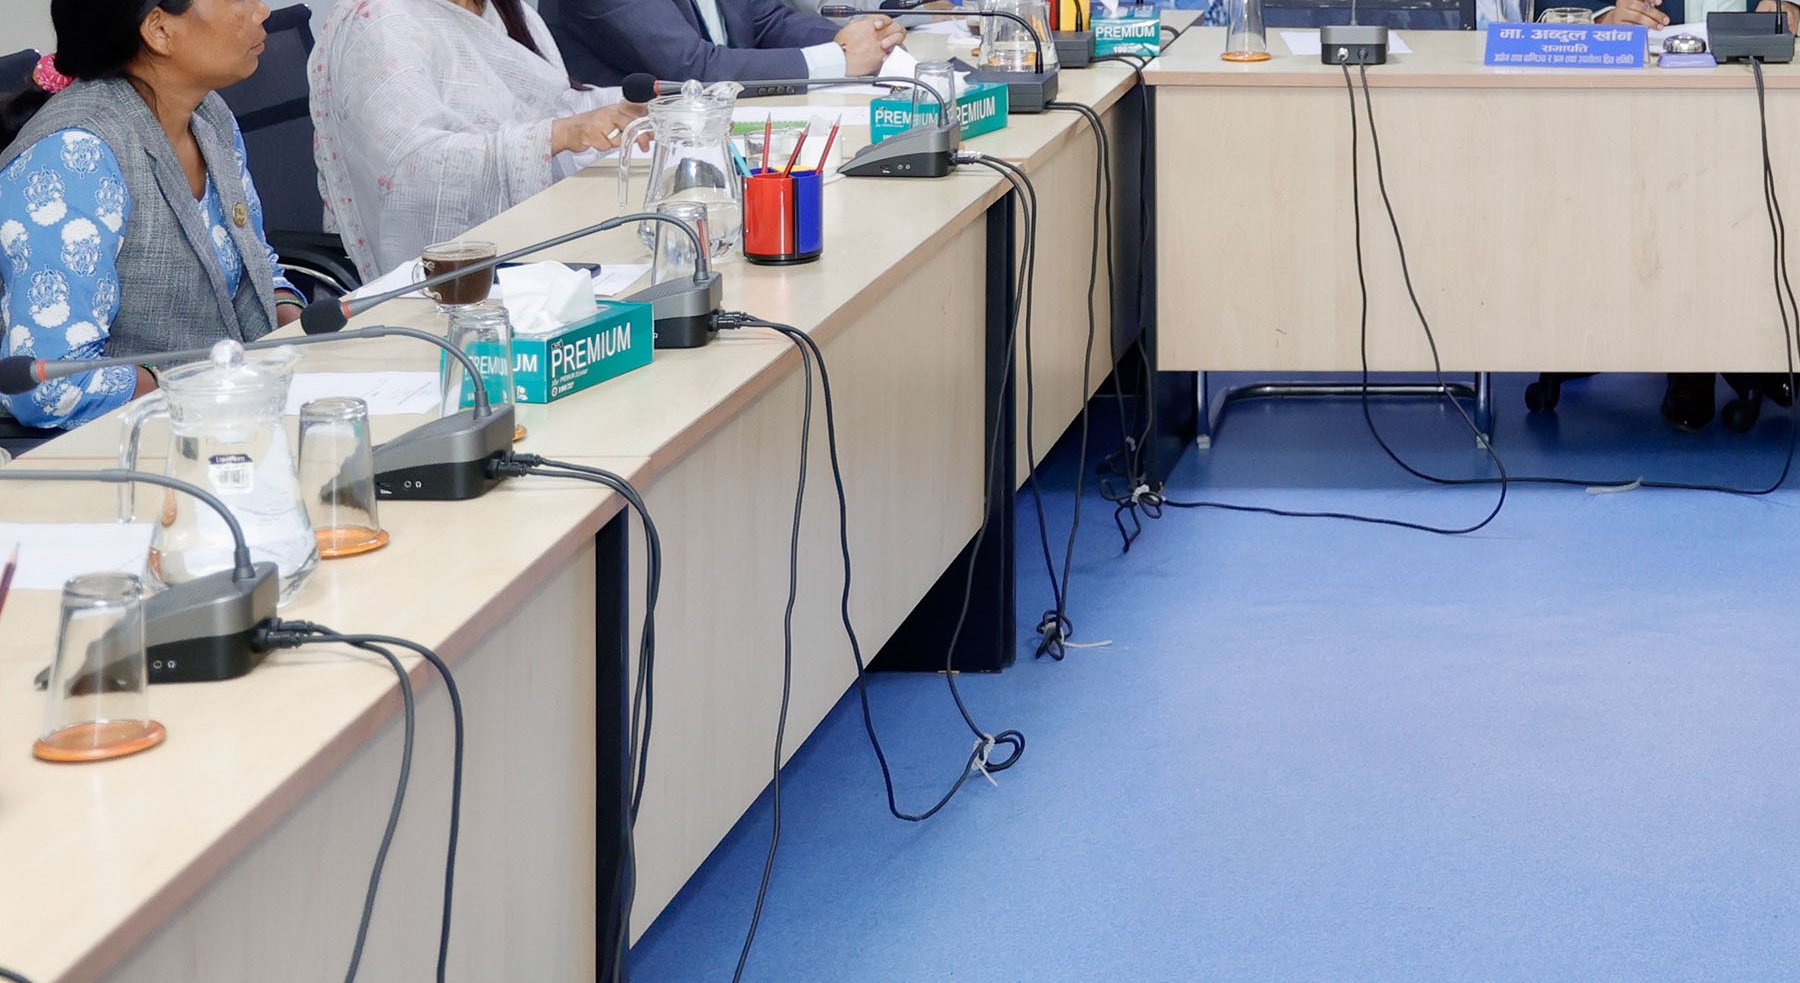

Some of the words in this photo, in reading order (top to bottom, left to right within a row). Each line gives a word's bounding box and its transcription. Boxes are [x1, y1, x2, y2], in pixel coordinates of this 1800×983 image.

[1095, 26, 1156, 38] PREMIUM
[947, 96, 996, 126] REMIUM
[551, 322, 632, 378] PREMIUM
